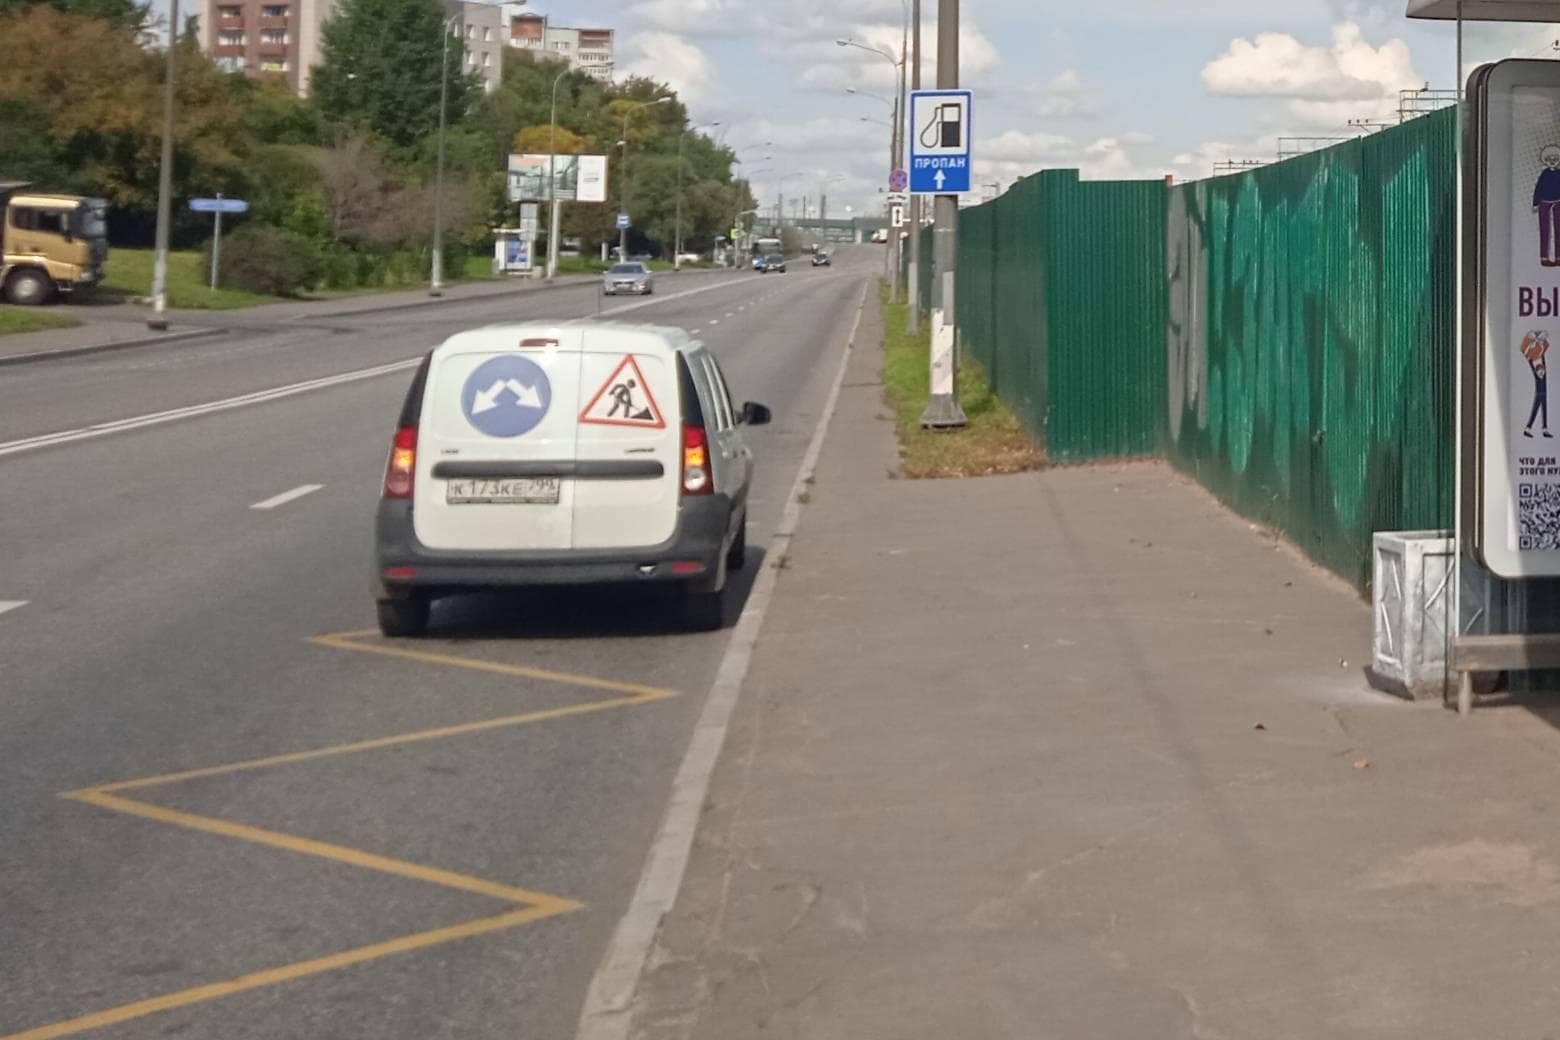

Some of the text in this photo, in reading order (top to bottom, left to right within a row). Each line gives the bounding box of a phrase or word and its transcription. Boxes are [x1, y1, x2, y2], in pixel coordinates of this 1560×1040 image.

[914, 158, 966, 168] ПРОПАН
[1519, 456, 1556, 466] ЧТО ДЛЯ
[1519, 467, 1545, 476] ЭТОГО
